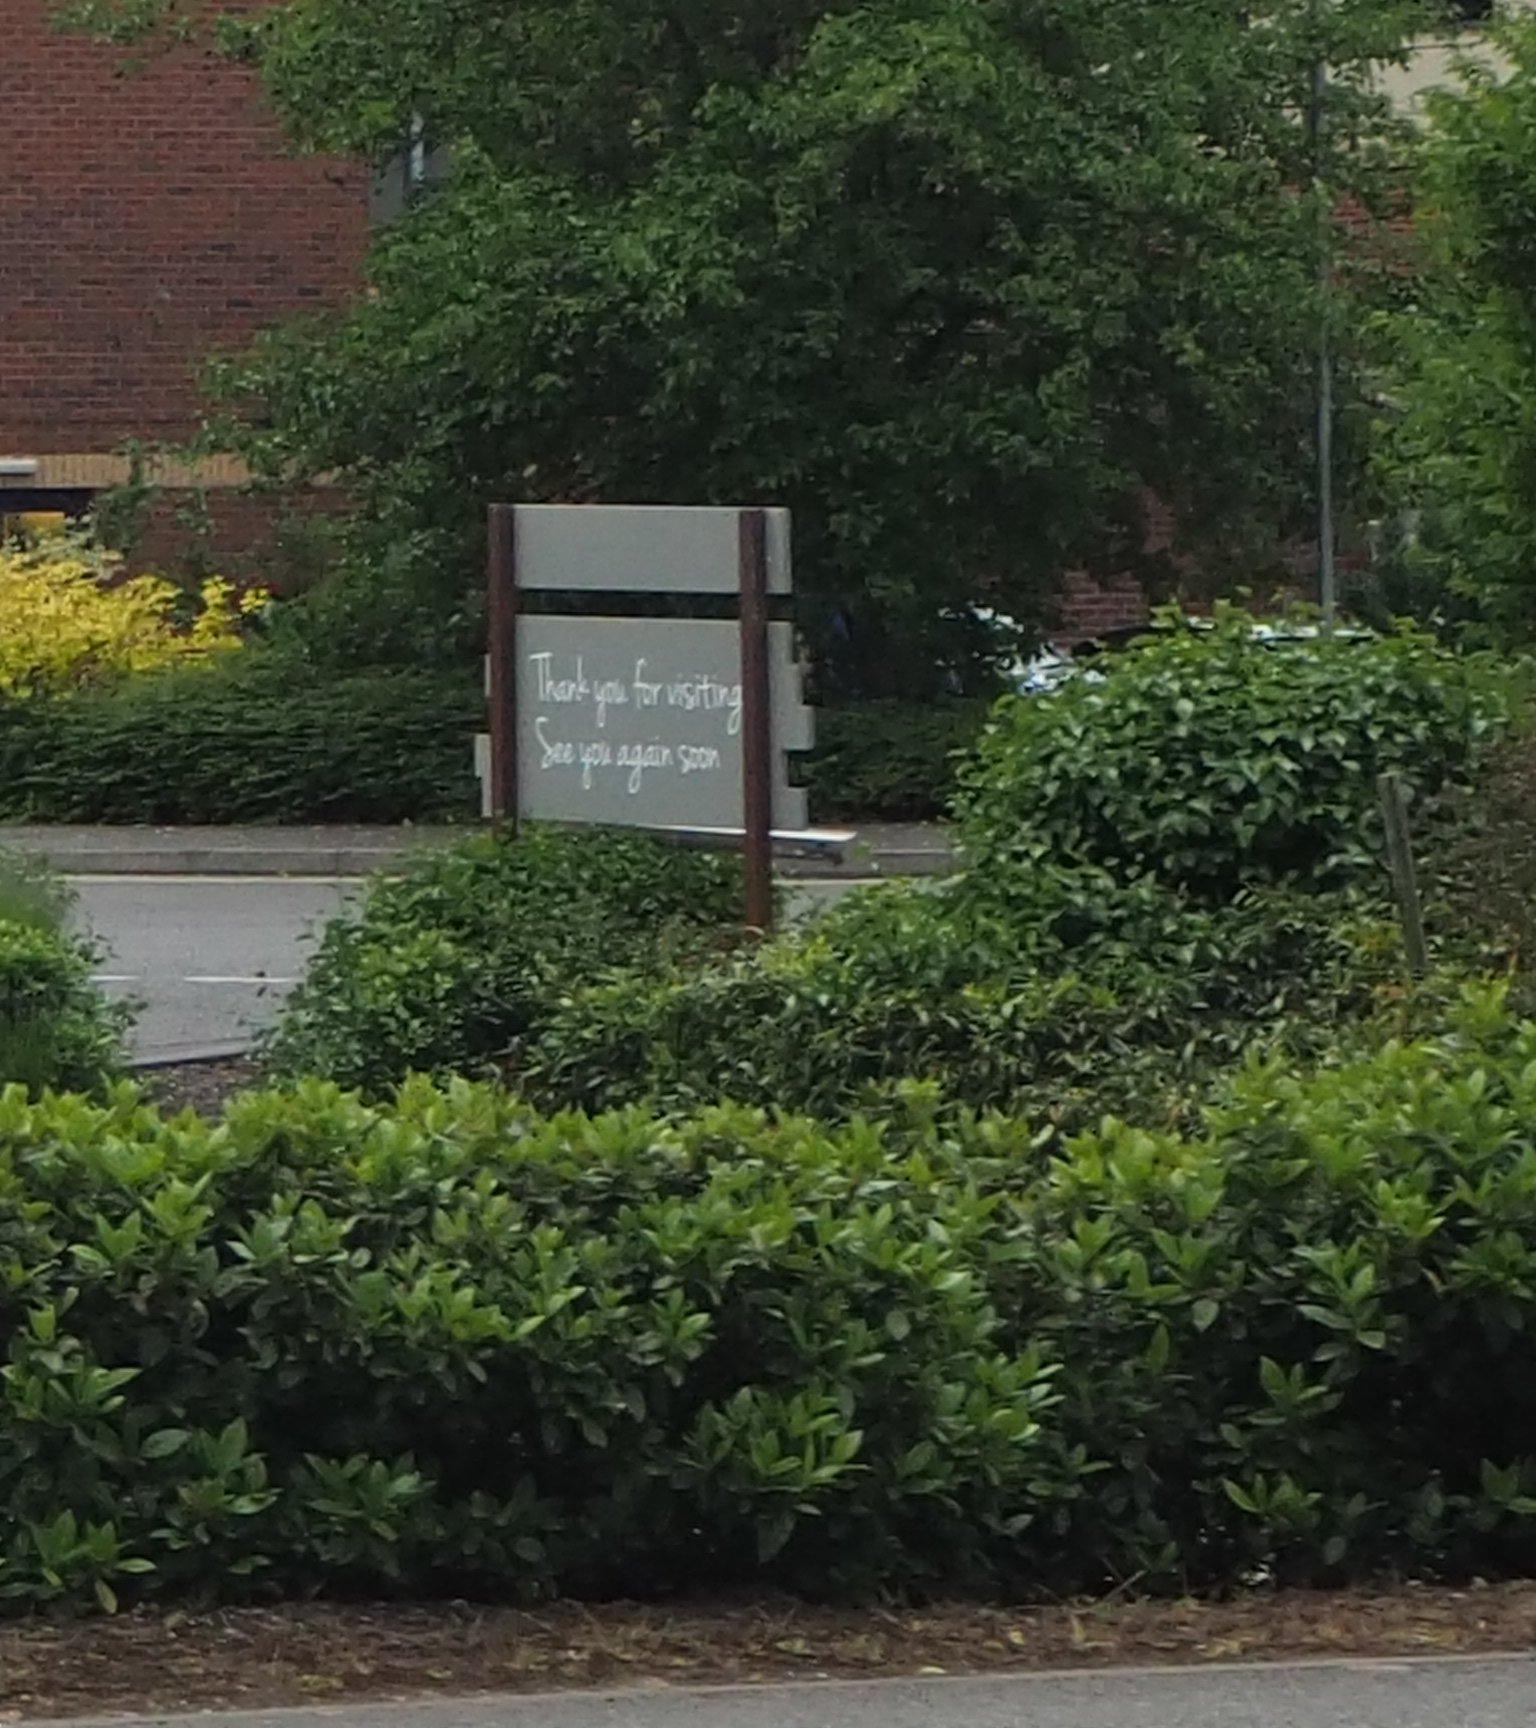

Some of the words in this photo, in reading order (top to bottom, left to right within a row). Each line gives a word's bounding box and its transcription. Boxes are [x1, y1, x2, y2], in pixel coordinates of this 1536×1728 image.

[529, 652, 590, 702] Thank
[592, 680, 628, 728] you
[632, 658, 663, 709] for
[666, 673, 743, 735] visiting
[535, 716, 574, 770] See
[579, 742, 611, 790] you
[617, 736, 673, 794] again
[678, 744, 721, 773] soon
